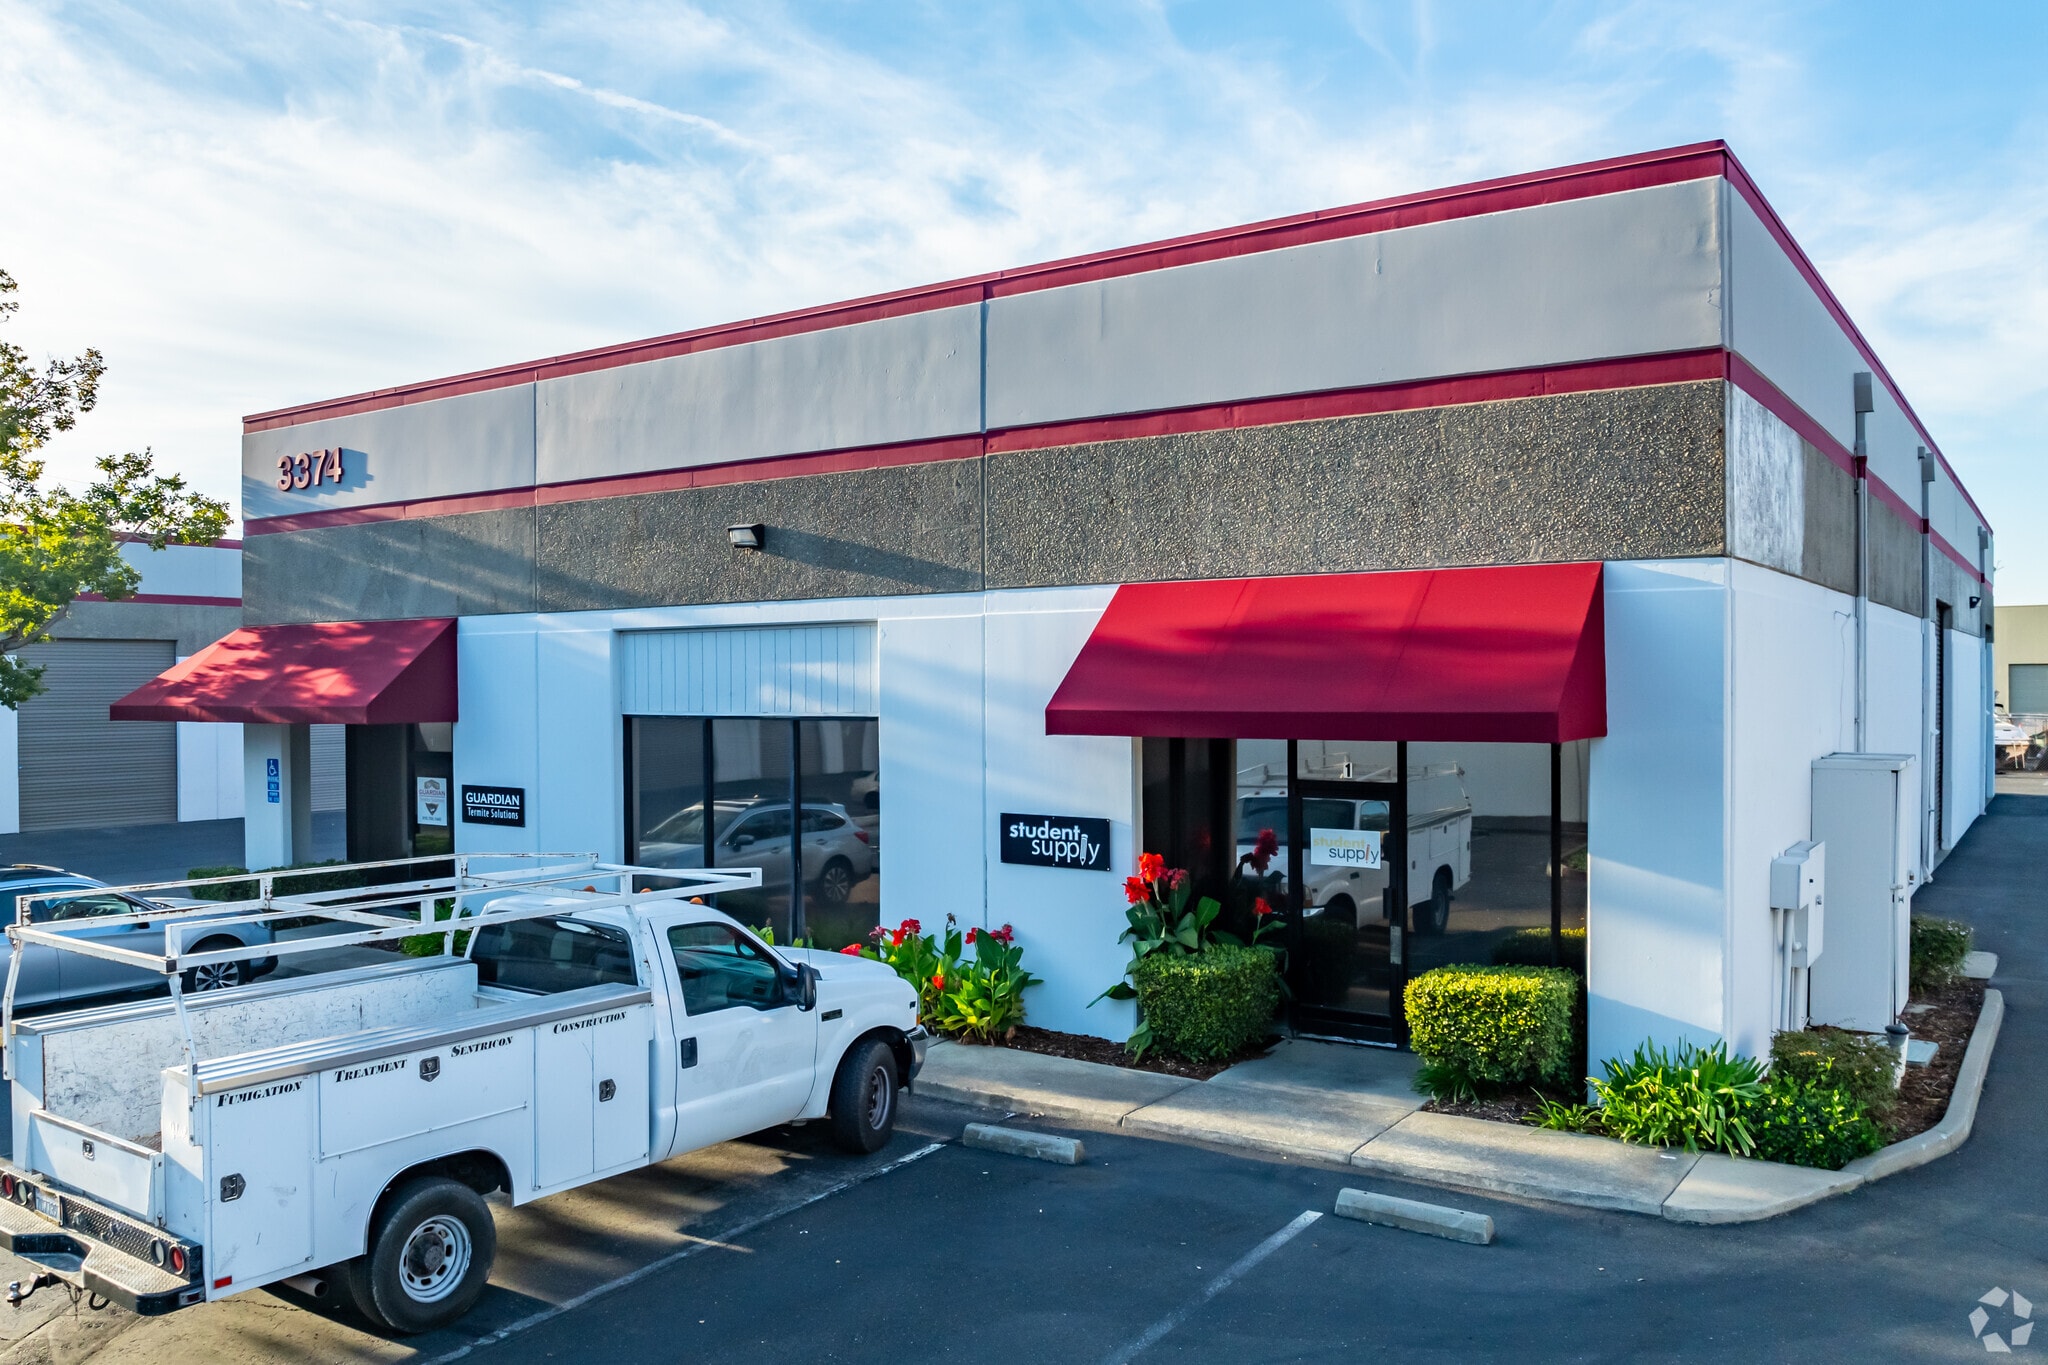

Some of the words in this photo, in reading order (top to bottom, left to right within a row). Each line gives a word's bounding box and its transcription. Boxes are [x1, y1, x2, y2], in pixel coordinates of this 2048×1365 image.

[277, 447, 344, 491] 3374
[1345, 763, 1351, 777] 1
[465, 792, 520, 806] GUARDIAN
[467, 807, 490, 818] Termite
[490, 808, 519, 820] Solutions
[1009, 820, 1080, 841] student
[1031, 833, 1100, 866] supply
[1313, 836, 1365, 849] student
[1328, 844, 1379, 864] supply
[217, 1080, 303, 1108] FUMIGATION
[335, 1058, 408, 1083] TREATMENT
[450, 1035, 514, 1058] SENTRICON
[553, 1011, 627, 1035] CONSTRUCTION
